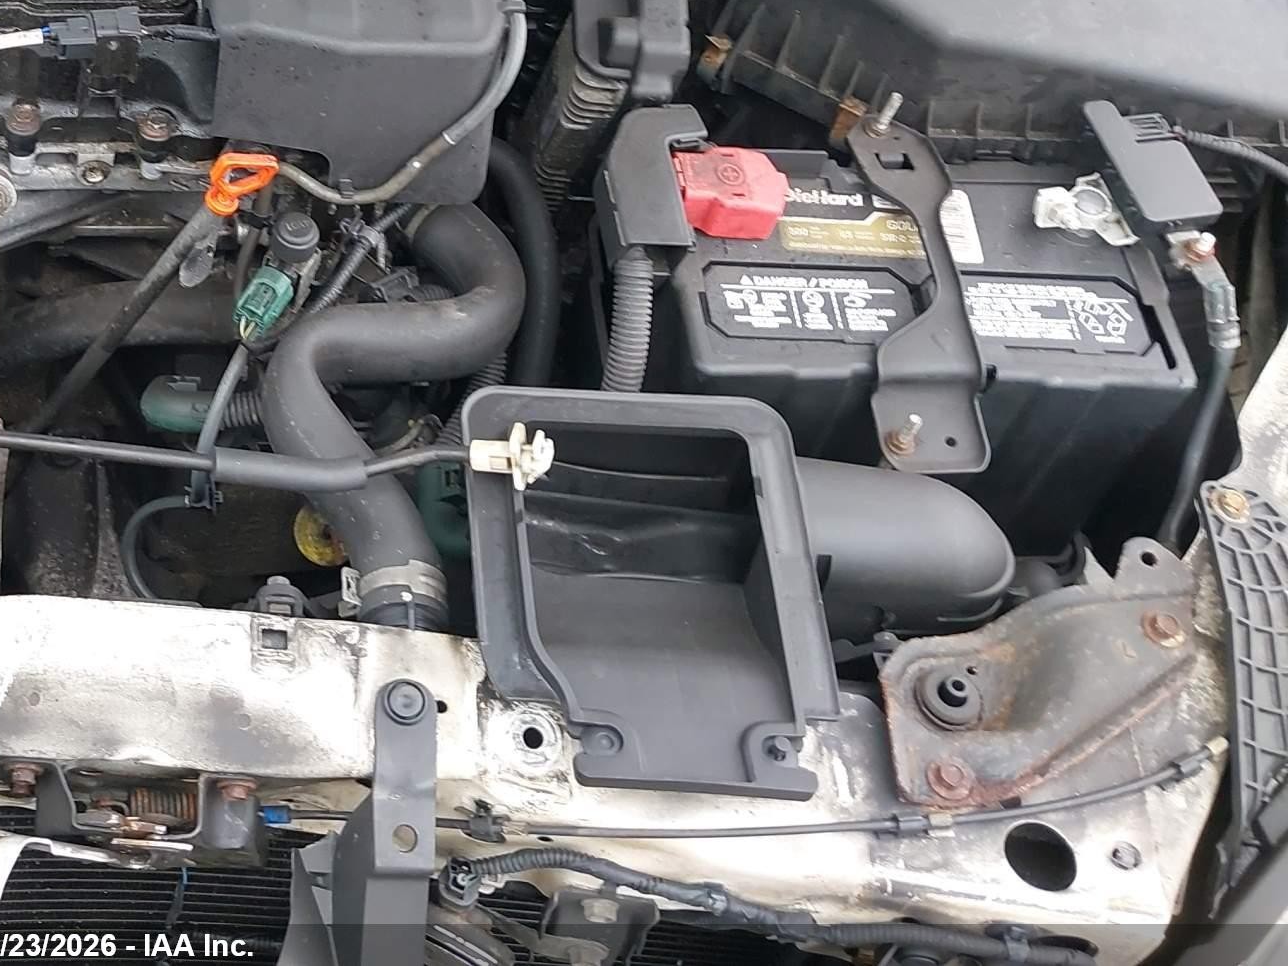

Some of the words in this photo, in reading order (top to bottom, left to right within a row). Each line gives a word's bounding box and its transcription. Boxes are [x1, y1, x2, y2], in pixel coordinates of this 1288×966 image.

[886, 220, 919, 233] GOL
[751, 275, 808, 288] DANGER
[818, 277, 869, 290] POISON
